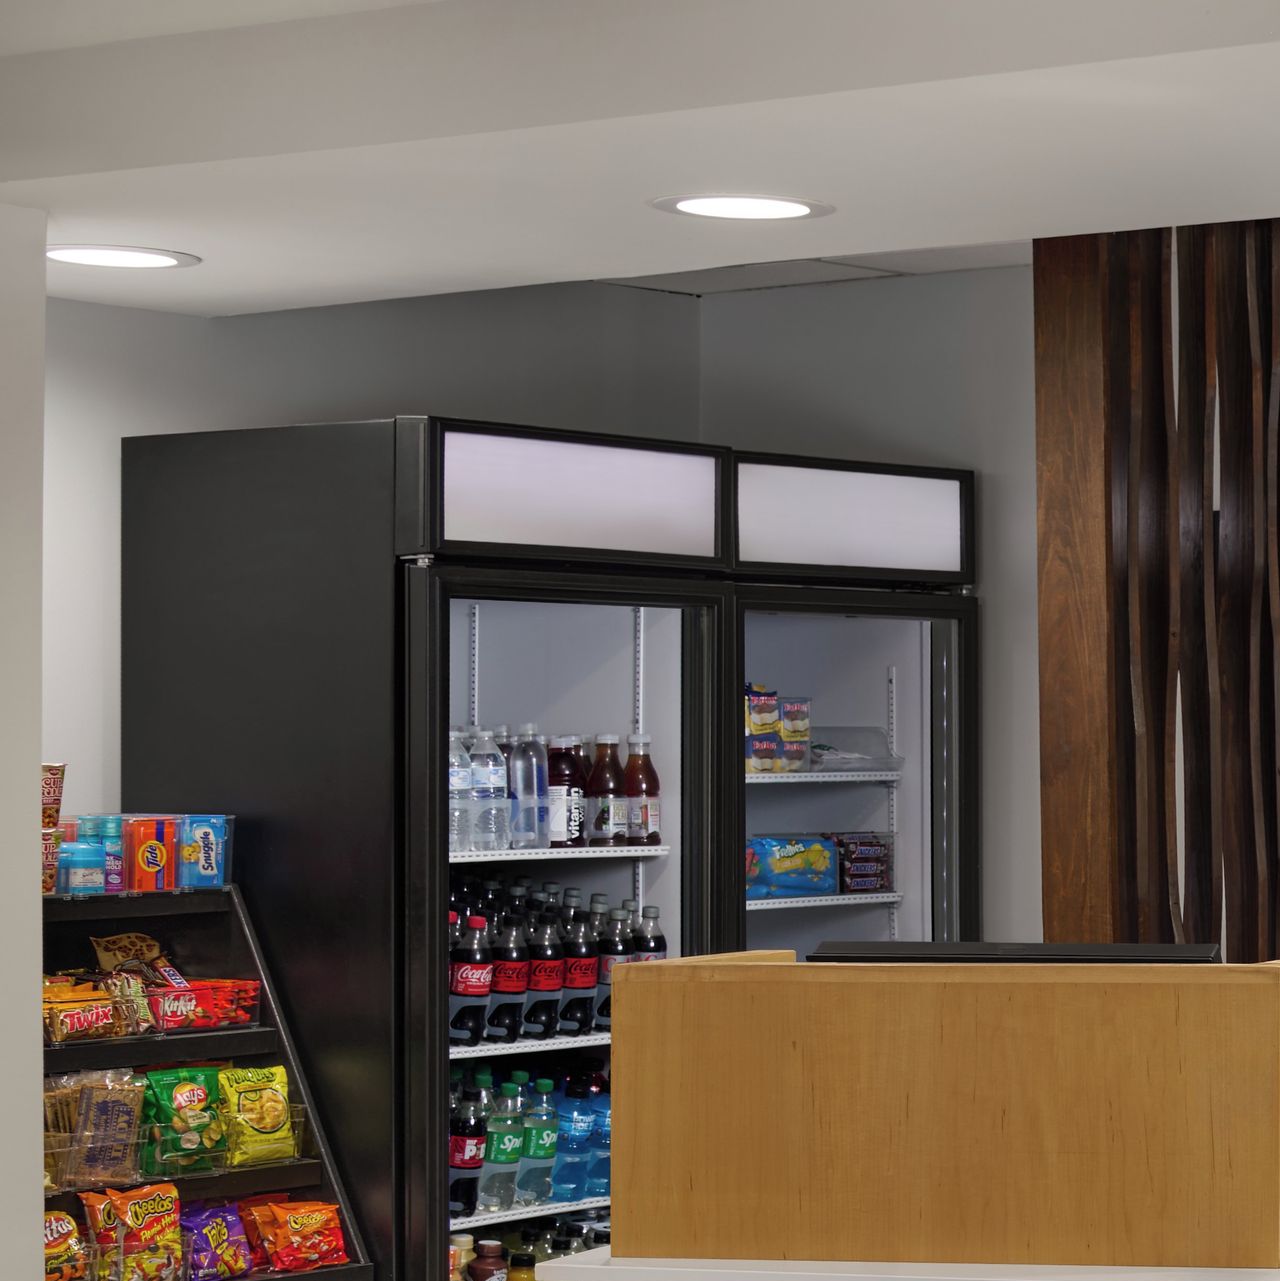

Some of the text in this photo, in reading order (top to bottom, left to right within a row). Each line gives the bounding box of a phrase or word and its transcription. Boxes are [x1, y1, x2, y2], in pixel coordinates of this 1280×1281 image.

[568, 787, 581, 839] vitamin
[146, 845, 162, 869] Tide
[202, 831, 214, 871] Snuggle
[63, 1005, 112, 1032] Twix
[176, 1089, 205, 1107] Lay's
[128, 1193, 174, 1227] Cheetos
[44, 1216, 74, 1243] itos
